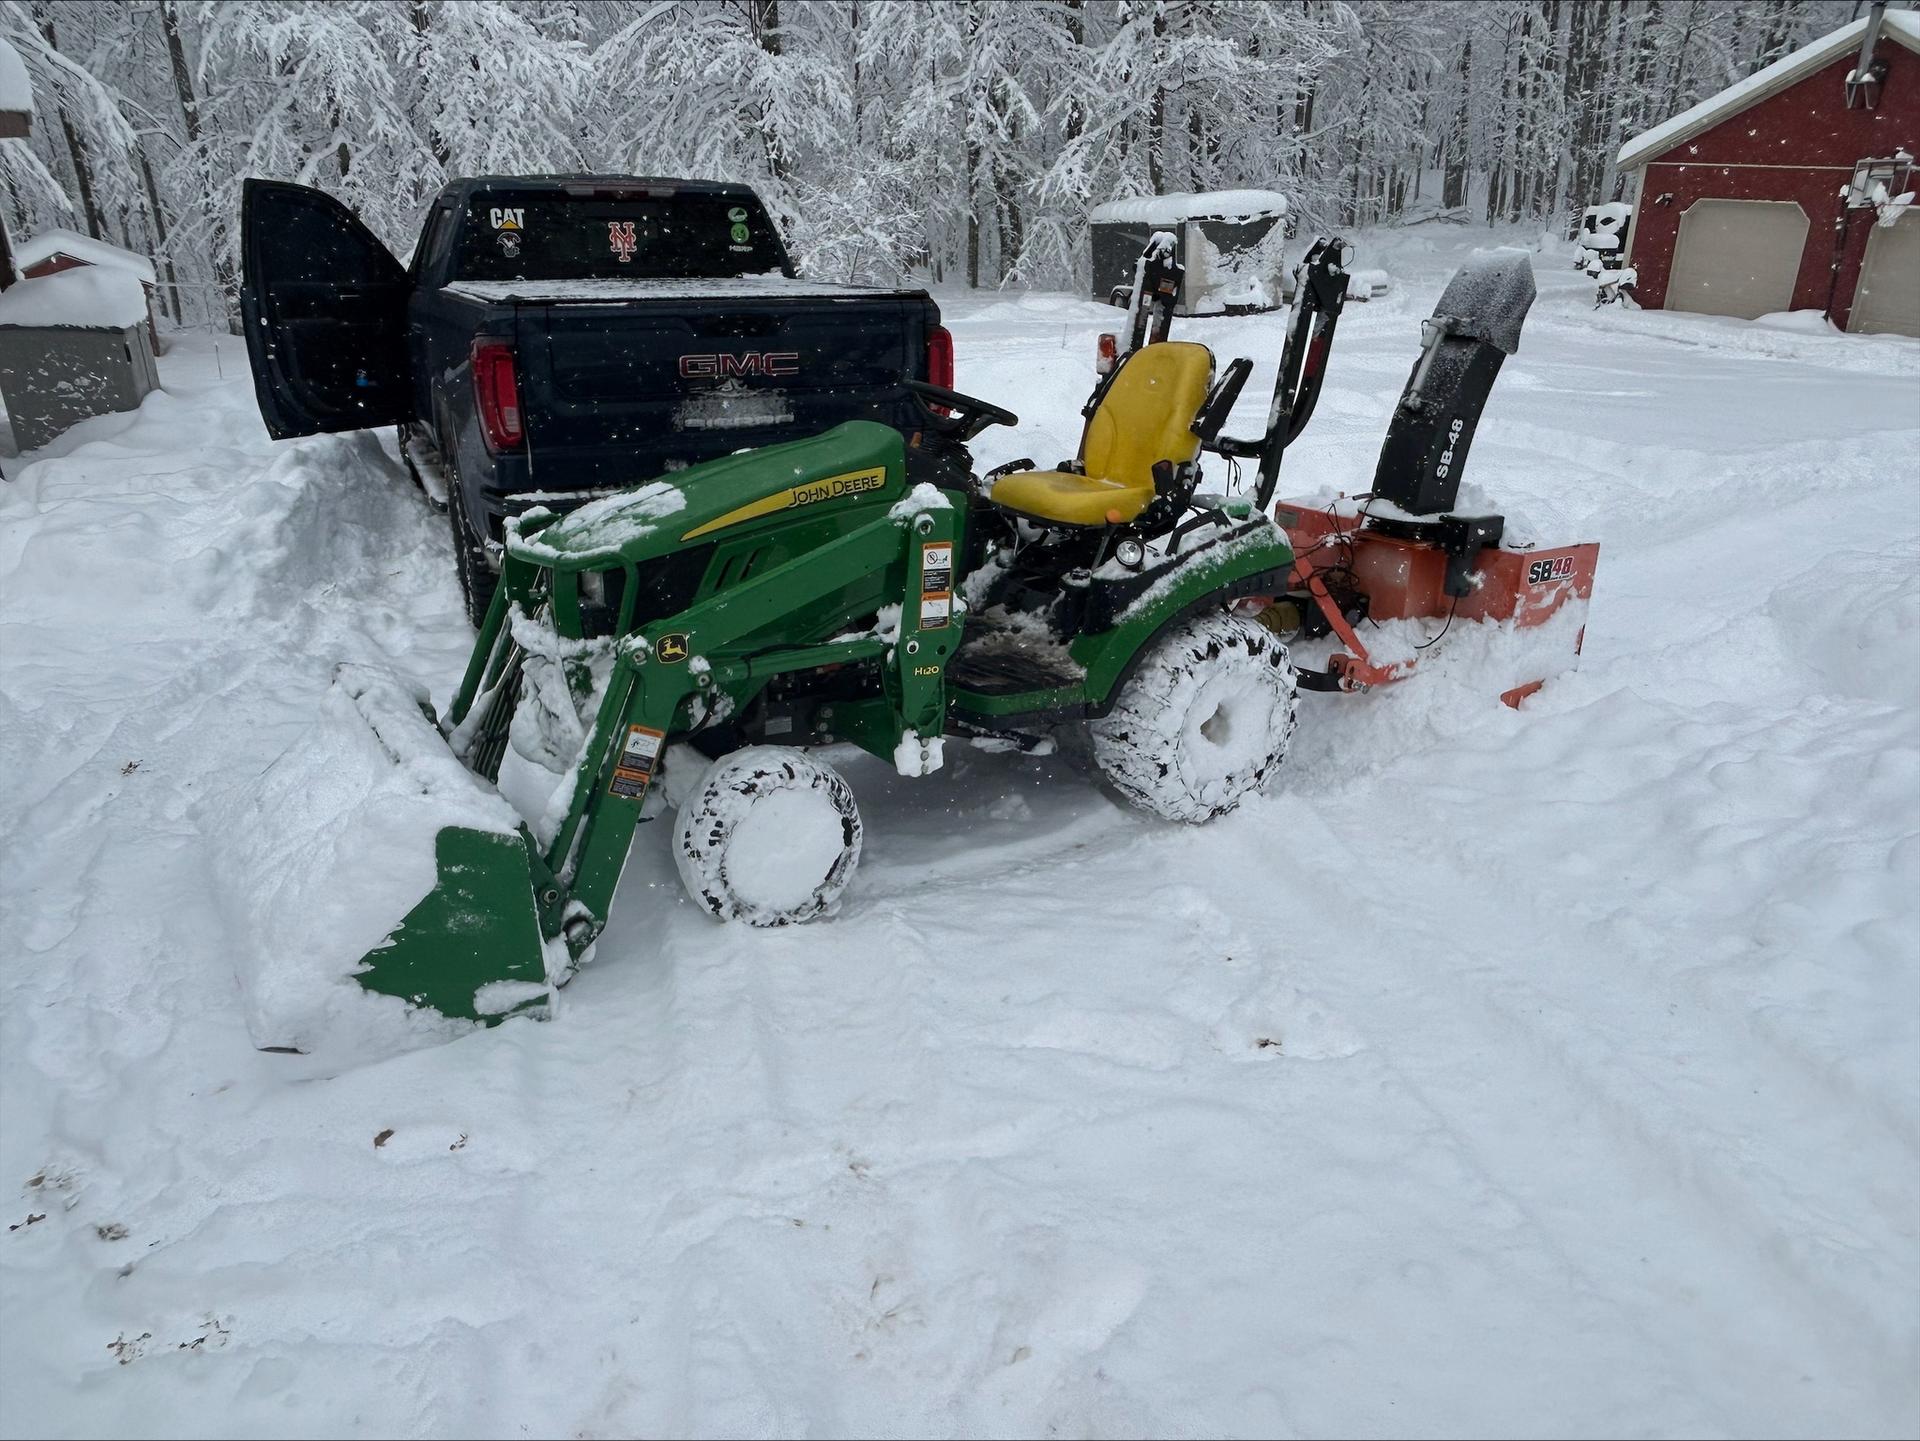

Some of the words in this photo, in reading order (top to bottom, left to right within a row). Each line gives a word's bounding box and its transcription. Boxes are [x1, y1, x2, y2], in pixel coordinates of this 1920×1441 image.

[489, 208, 525, 230] CAT
[679, 352, 799, 378] GMC
[1436, 418, 1464, 479] SB-48
[1528, 557, 1574, 584] SB48
